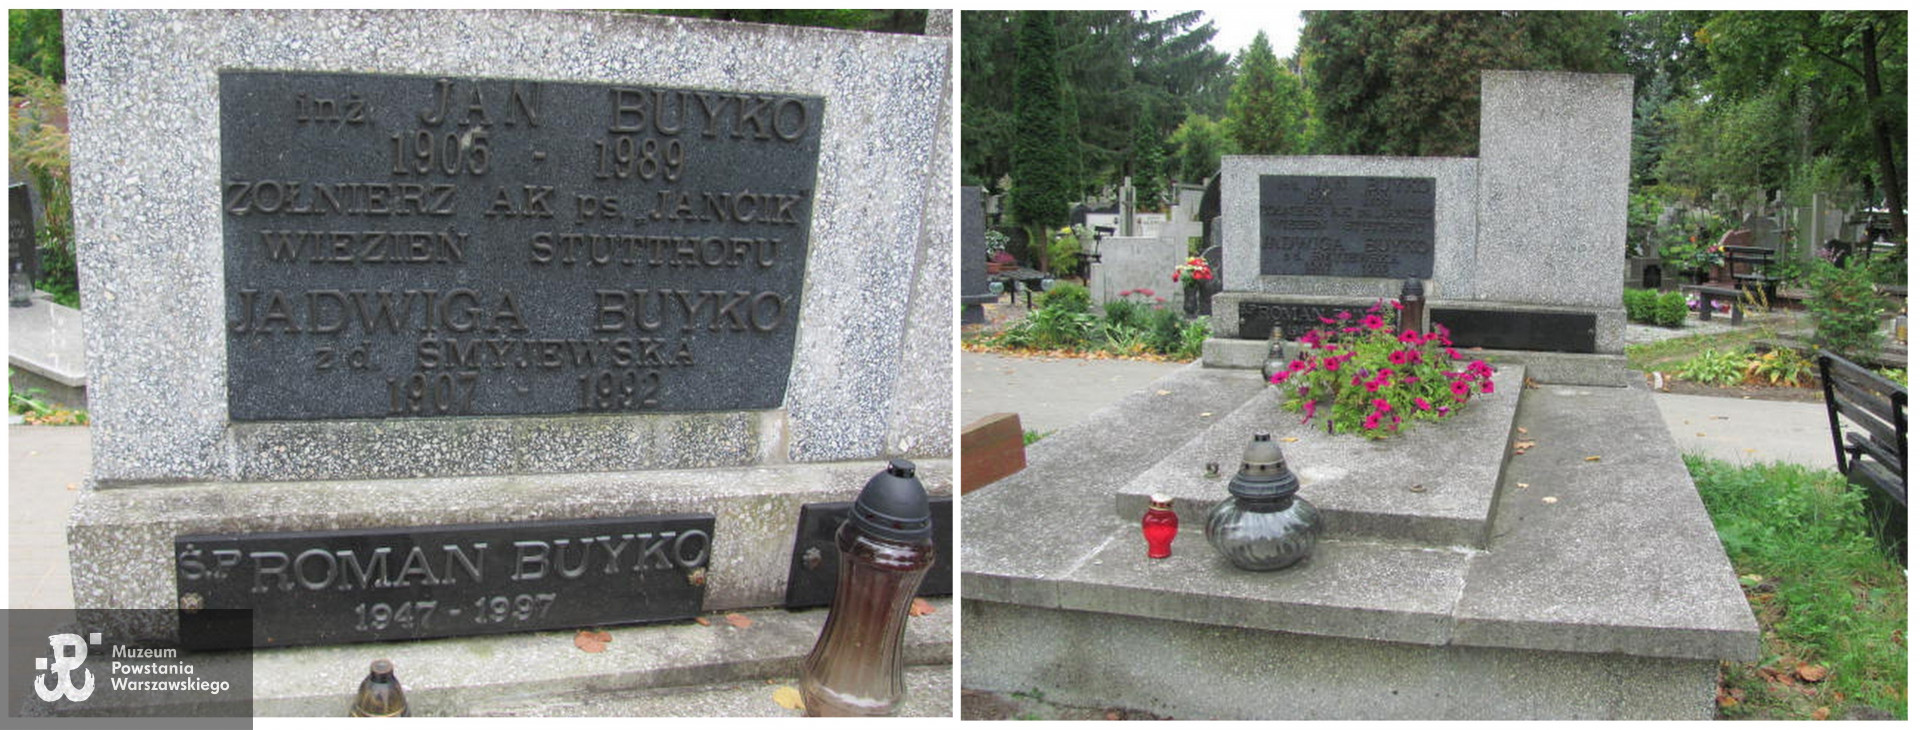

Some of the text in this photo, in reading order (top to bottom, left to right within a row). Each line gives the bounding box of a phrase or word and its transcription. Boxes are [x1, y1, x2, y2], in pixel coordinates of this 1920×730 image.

[419, 78, 544, 128] JAN
[608, 87, 809, 142] BUYKO
[389, 128, 490, 176] 1905
[595, 135, 684, 182] 1989
[484, 184, 554, 217] AK
[529, 231, 782, 268] STUTTHOFU
[229, 288, 787, 333] JADWIGA BUYKO
[385, 371, 479, 413] 1907
[574, 367, 662, 411] 1992
[249, 541, 488, 593] ROMAN
[510, 528, 711, 582] BUYKO
[353, 599, 439, 632] 1947
[473, 592, 558, 625] 1997
